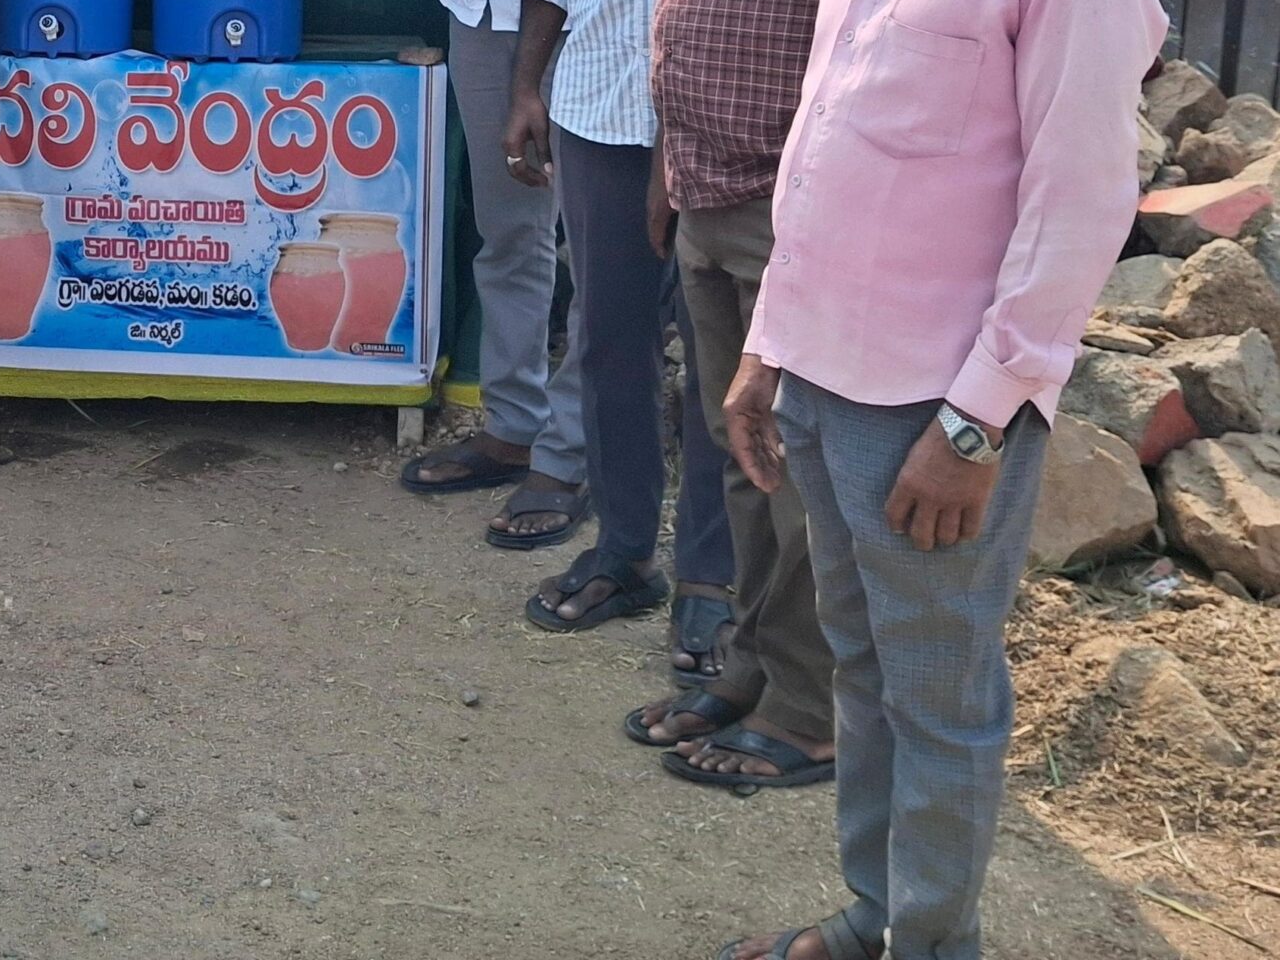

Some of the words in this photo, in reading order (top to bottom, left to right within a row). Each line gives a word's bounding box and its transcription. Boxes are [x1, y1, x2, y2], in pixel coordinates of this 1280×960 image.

[65, 194, 123, 224] గ్రామ
[128, 195, 246, 224] పంచాయితి
[84, 235, 231, 272] కార్యాలయము
